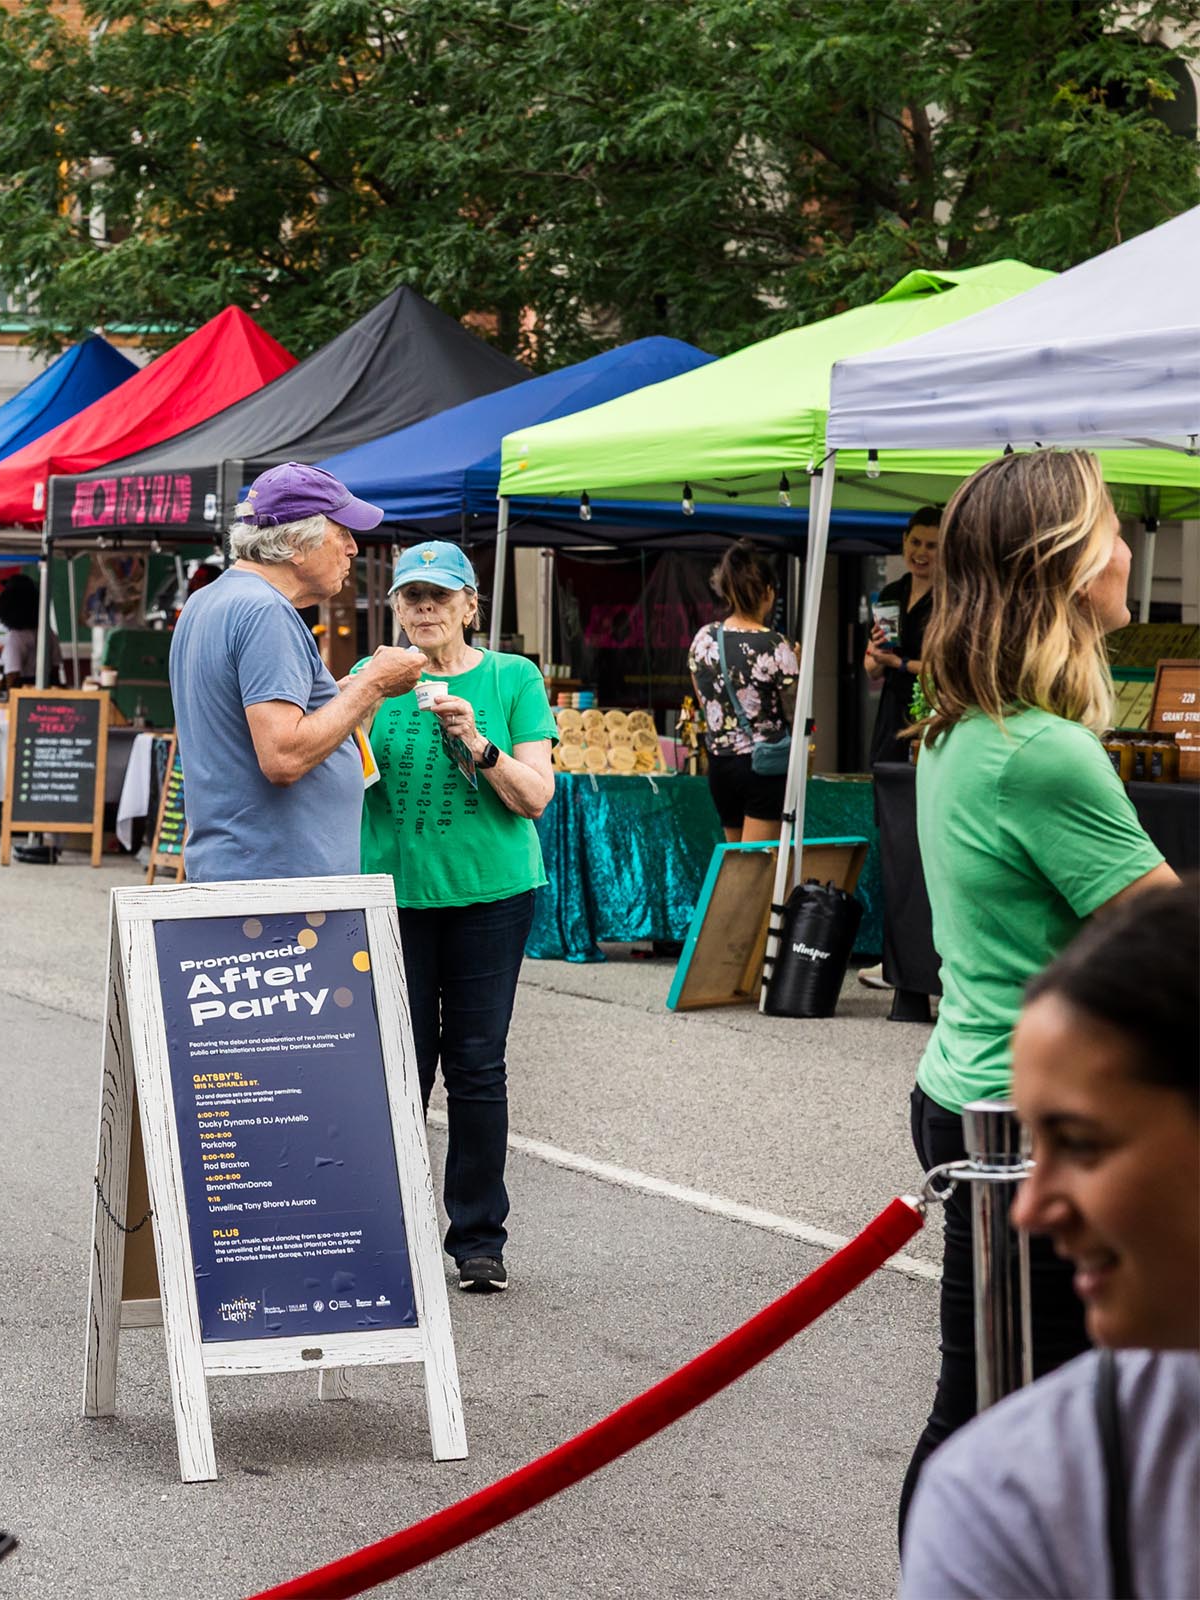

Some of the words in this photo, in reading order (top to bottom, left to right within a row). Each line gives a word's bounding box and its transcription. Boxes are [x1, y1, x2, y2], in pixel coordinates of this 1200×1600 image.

[1162, 712, 1185, 722] GRANT
[792, 942, 831, 961] Winsper
[180, 944, 307, 972] Promenade
[187, 962, 313, 999] After
[190, 988, 330, 1027] Party
[189, 1041, 218, 1049] Featuring
[261, 1036, 296, 1044] celebration
[317, 1034, 339, 1042] Inviting
[340, 1032, 356, 1041] Light
[190, 1049, 209, 1057] public
[219, 1046, 256, 1055] installations
[281, 1044, 289, 1052] by
[289, 1043, 312, 1051] Derrick
[193, 1072, 243, 1082] GATSBY'S:
[216, 1080, 249, 1088] CHARLES
[213, 1098, 236, 1106] unveiling
[197, 1111, 230, 1119] 6:00-7:00
[198, 1120, 223, 1129] Ducky
[223, 1118, 256, 1128] Dynamo
[262, 1117, 274, 1125] DJ
[201, 1140, 237, 1149] Porkchop
[202, 1153, 235, 1161] 8:00-9:00
[203, 1162, 219, 1171] Rod
[220, 1160, 250, 1169] Braxton
[206, 1181, 273, 1192] BmoreThanDance
[208, 1204, 243, 1213] Unveiling
[243, 1202, 262, 1210] Tony
[262, 1200, 290, 1209] Shore's
[291, 1199, 317, 1207] Aurora
[212, 1228, 239, 1239] PLUS
[214, 1239, 231, 1247] More
[231, 1238, 241, 1246] art,
[242, 1237, 262, 1245] music,
[275, 1235, 300, 1243] dancing
[350, 1229, 362, 1237] and
[226, 1246, 253, 1254] unveiling
[284, 1242, 303, 1250] Snake
[235, 1254, 258, 1262] Charles
[278, 1251, 303, 1259] Garage,
[220, 1299, 257, 1312] Inviting
[222, 1310, 248, 1322] Light
